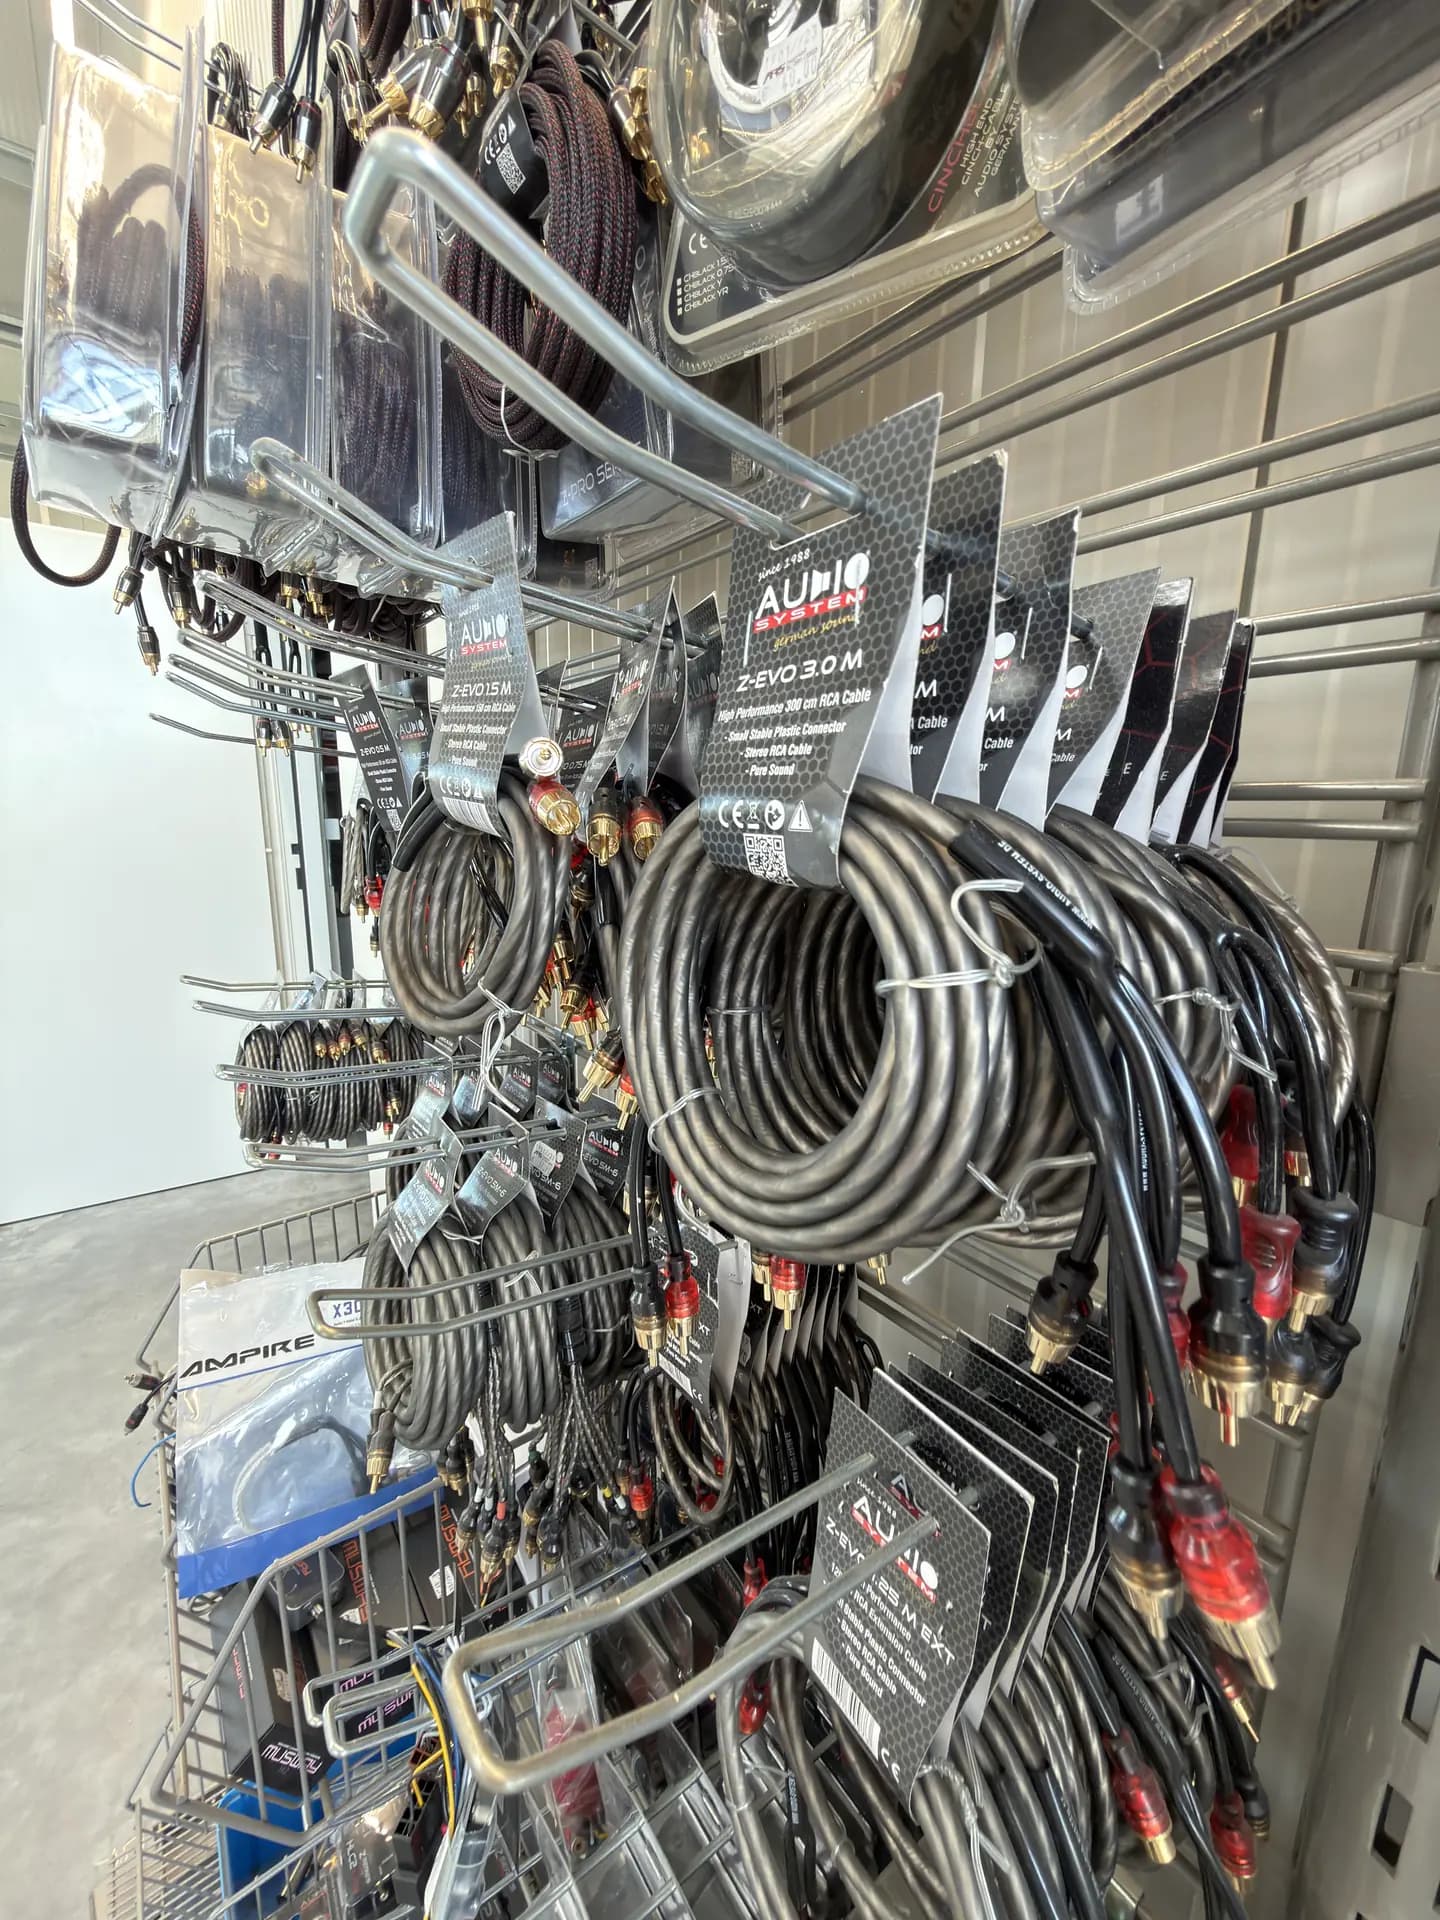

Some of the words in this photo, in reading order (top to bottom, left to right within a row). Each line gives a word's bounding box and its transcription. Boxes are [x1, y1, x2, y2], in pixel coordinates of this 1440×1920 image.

[960, 133, 978, 168] HIGH
[976, 97, 993, 129] END
[962, 82, 1007, 185] CINCH-CABLE
[974, 149, 998, 198] AUDIO
[996, 97, 1019, 146] SYST
[985, 126, 999, 149] BY
[683, 263, 715, 283] CHBLACK
[683, 283, 715, 303] CHBLACK
[716, 279, 723, 287] Y
[684, 293, 716, 312] CHBLACK
[717, 286, 729, 297] YR
[758, 563, 781, 582] since
[784, 548, 810, 569] 1988
[755, 552, 870, 619] AUDIO
[754, 587, 865, 632] SYSTEM
[461, 614, 507, 646] AUDIO
[773, 625, 817, 652] german
[461, 639, 507, 655] SYSTEM
[736, 664, 797, 692] Z-EVO
[800, 655, 837, 680] 3.0
[840, 648, 862, 672] M
[452, 682, 484, 697] Z-EVO
[501, 680, 511, 695] M
[353, 711, 376, 727] AUDIO
[718, 711, 735, 723] High
[735, 703, 784, 719] Performance
[785, 698, 802, 712] 300
[803, 699, 817, 710] cm
[819, 692, 839, 707] RCA
[842, 687, 871, 704] Cable
[564, 724, 595, 742] AUDIO
[728, 728, 749, 742] Small
[749, 728, 773, 741] Stable
[774, 724, 801, 738] Plastic
[802, 720, 847, 735] Connector
[917, 715, 948, 730] Cable
[744, 746, 769, 758] Stereo
[769, 744, 787, 756] RCA
[788, 743, 812, 756] Cable
[984, 737, 1014, 750] Cable
[750, 764, 767, 776] Pure
[768, 763, 795, 775] Sound
[589, 1131, 620, 1151] AUDIO
[698, 1321, 711, 1337] XT
[179, 1334, 315, 1379] AMPIRE
[852, 1507, 936, 1603] SYTEM
[853, 1496, 938, 1590] AUIO
[866, 1584, 911, 1642] Performance
[872, 1574, 900, 1607] 1.25
[901, 1604, 916, 1629] M
[921, 1624, 955, 1665] EXT
[854, 1590, 868, 1613] RCA
[869, 1608, 904, 1654] Extension
[905, 1650, 927, 1681] Cable
[841, 1620, 861, 1651] Stereo
[862, 1646, 876, 1669] RCA
[877, 1665, 897, 1696] Cable
[844, 1603, 864, 1633] Stable
[865, 1629, 887, 1662] Plastic
[888, 1657, 926, 1707] Connector
[845, 1645, 860, 1670] Pure
[861, 1666, 883, 1698] Sound
[261, 1744, 323, 1775] MUSWAY
